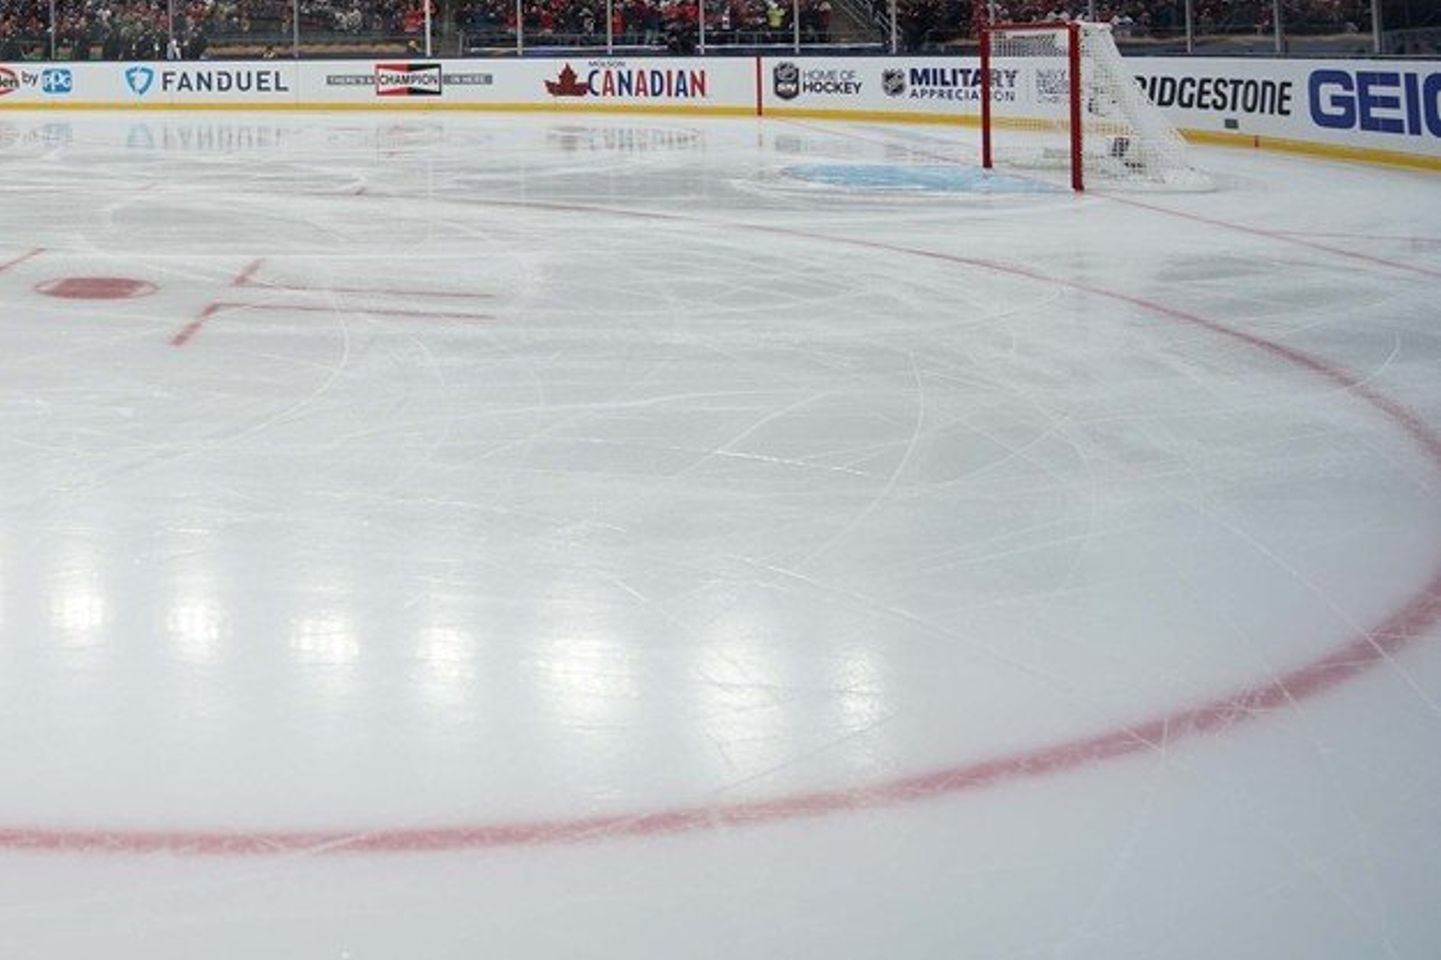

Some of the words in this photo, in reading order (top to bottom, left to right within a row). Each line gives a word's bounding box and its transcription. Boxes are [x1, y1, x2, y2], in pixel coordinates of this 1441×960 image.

[22, 71, 39, 87] by
[42, 69, 73, 92] PPG
[161, 71, 290, 92] FANDUEL
[379, 74, 439, 86] CHAMPION
[588, 69, 706, 97] CANADIAN
[803, 70, 836, 81] HOME
[840, 70, 856, 81] OF
[802, 82, 863, 95] HOCKEY
[909, 88, 1015, 102] APPRECIAON
[1134, 75, 1292, 116] IDGESTONE
